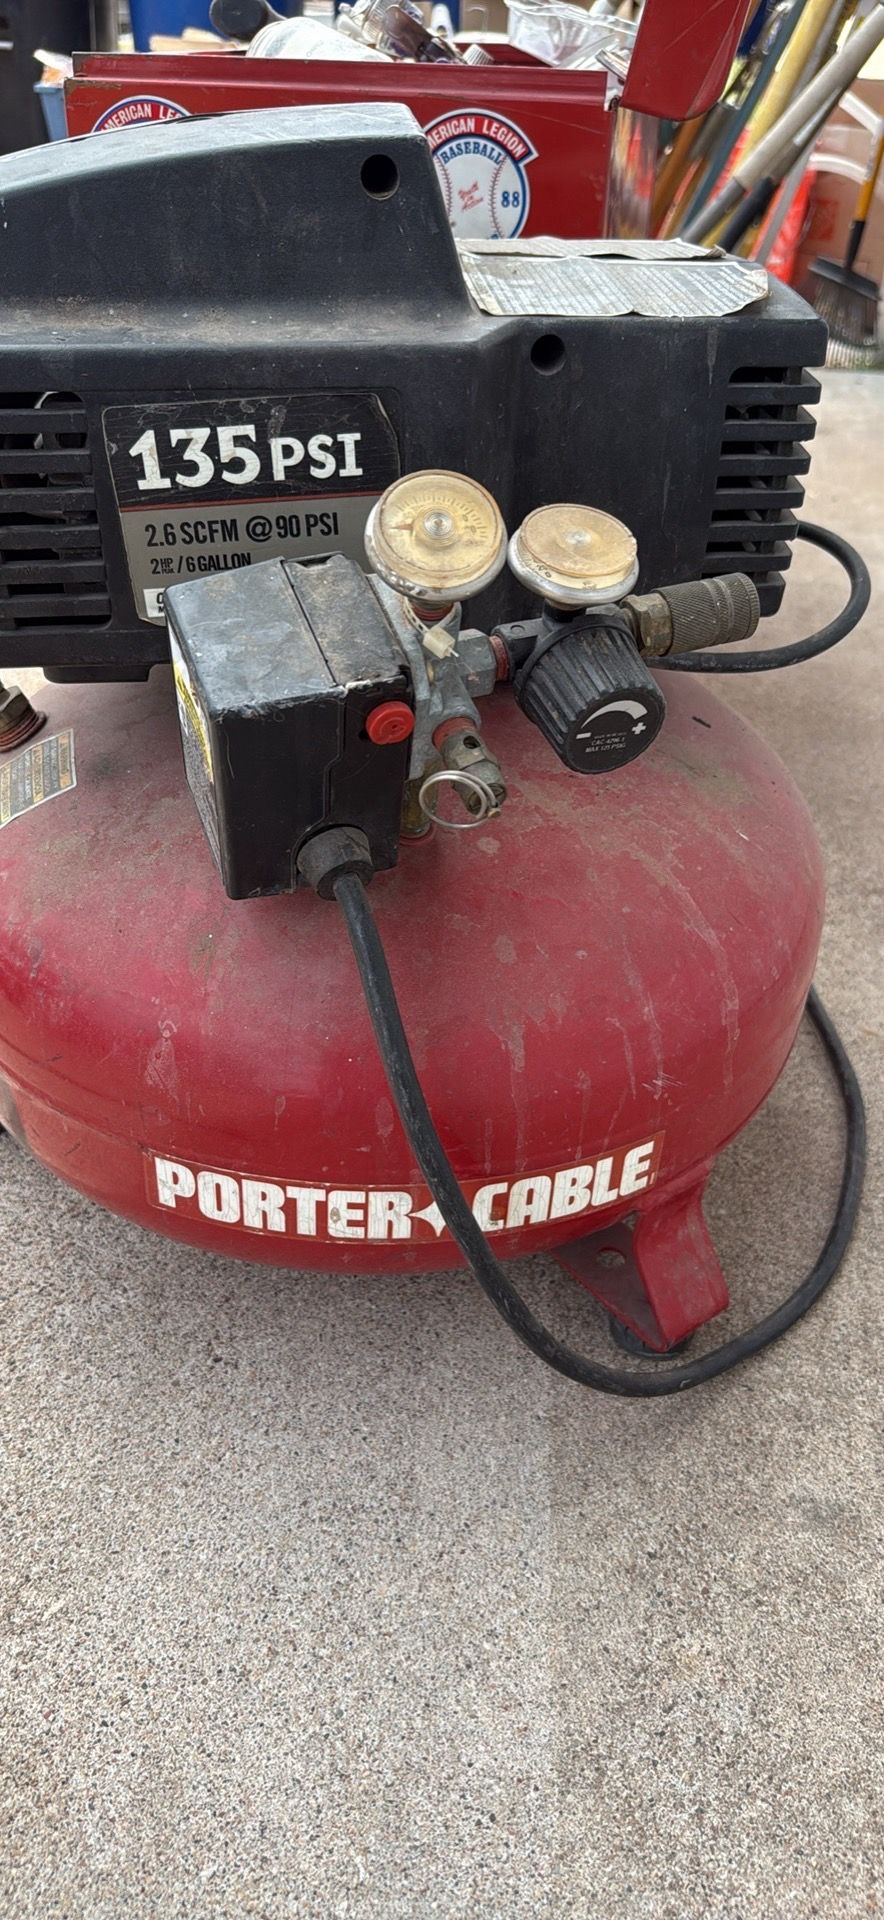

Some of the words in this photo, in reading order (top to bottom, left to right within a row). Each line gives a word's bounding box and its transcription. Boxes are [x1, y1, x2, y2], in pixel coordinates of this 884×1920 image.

[101, 103, 152, 130] MERICAN
[440, 141, 502, 165] BASEBALL
[482, 119, 527, 158] LEGION
[501, 191, 520, 208] 88
[128, 424, 261, 490] 135
[270, 432, 363, 481] PSI
[144, 523, 177, 548] 2.6
[181, 518, 240, 545] SCFM
[245, 515, 272, 543] @
[276, 514, 301, 539] 90
[305, 511, 339, 537] PSI
[150, 558, 160, 575] 2
[160, 557, 173, 569] HP
[186, 556, 196, 573] 6
[197, 552, 251, 573] GALLON
[154, 1156, 413, 1241] PORTER
[472, 1141, 654, 1231] CABLE
